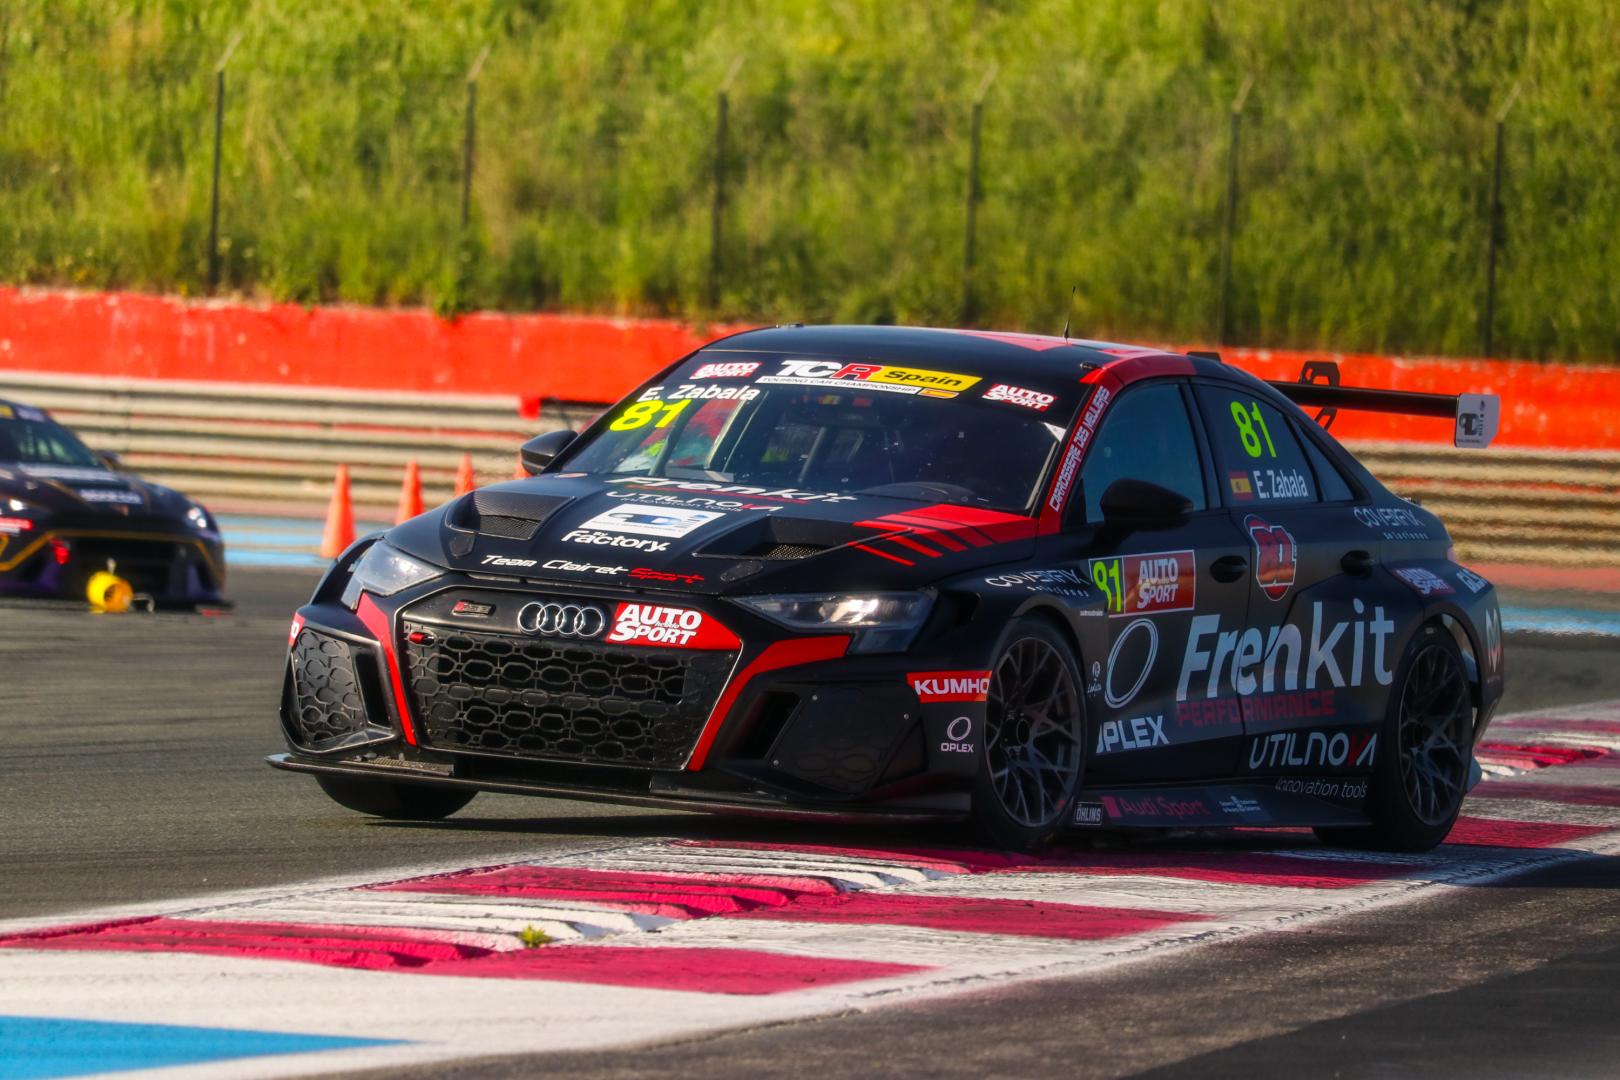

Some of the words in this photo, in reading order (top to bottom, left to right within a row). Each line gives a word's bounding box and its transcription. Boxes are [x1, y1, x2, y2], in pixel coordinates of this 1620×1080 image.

[697, 362, 760, 374] AUTO
[776, 359, 883, 381] TCR
[884, 370, 963, 387] Spain
[637, 386, 664, 403] E.
[668, 384, 760, 401] Zabala
[982, 392, 1049, 409] SPORT
[988, 384, 1055, 404] AUTO
[610, 399, 692, 432] 81
[1230, 401, 1277, 458] 81
[481, 555, 537, 568] Team
[542, 560, 628, 575] Clairet
[628, 567, 704, 583] Sport
[1138, 558, 1178, 585] AUTO
[1137, 583, 1178, 608] SPORT
[616, 603, 702, 630] AUTO
[609, 620, 697, 645] SPORT
[1176, 597, 1395, 701] Frenkit
[914, 678, 990, 695] KUMHO
[1176, 690, 1337, 728] PERFORMANCE
[941, 742, 974, 752] OPLEX
[1341, 781, 1368, 798] tools
[1120, 797, 1160, 816] Audi
[1158, 797, 1212, 819] Sport
